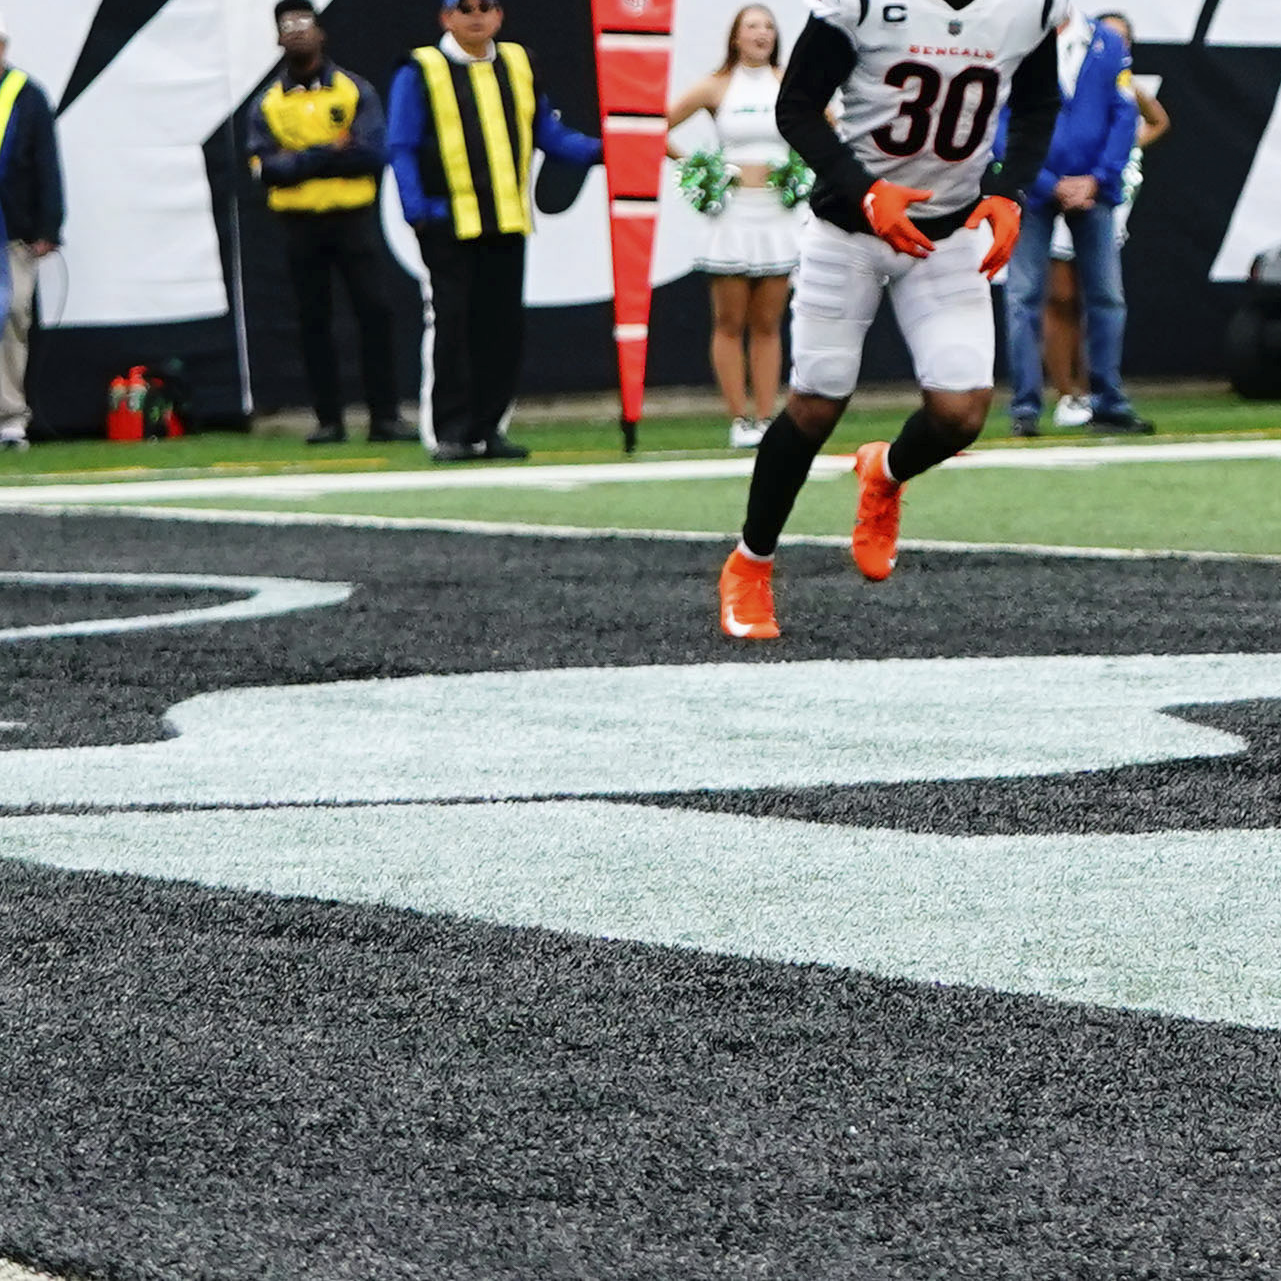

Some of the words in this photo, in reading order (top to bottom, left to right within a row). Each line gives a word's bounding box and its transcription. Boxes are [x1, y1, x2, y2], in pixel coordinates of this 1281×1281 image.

[882, 4, 908, 23] C
[909, 44, 996, 60] BENGALS
[870, 60, 1001, 163] 30
